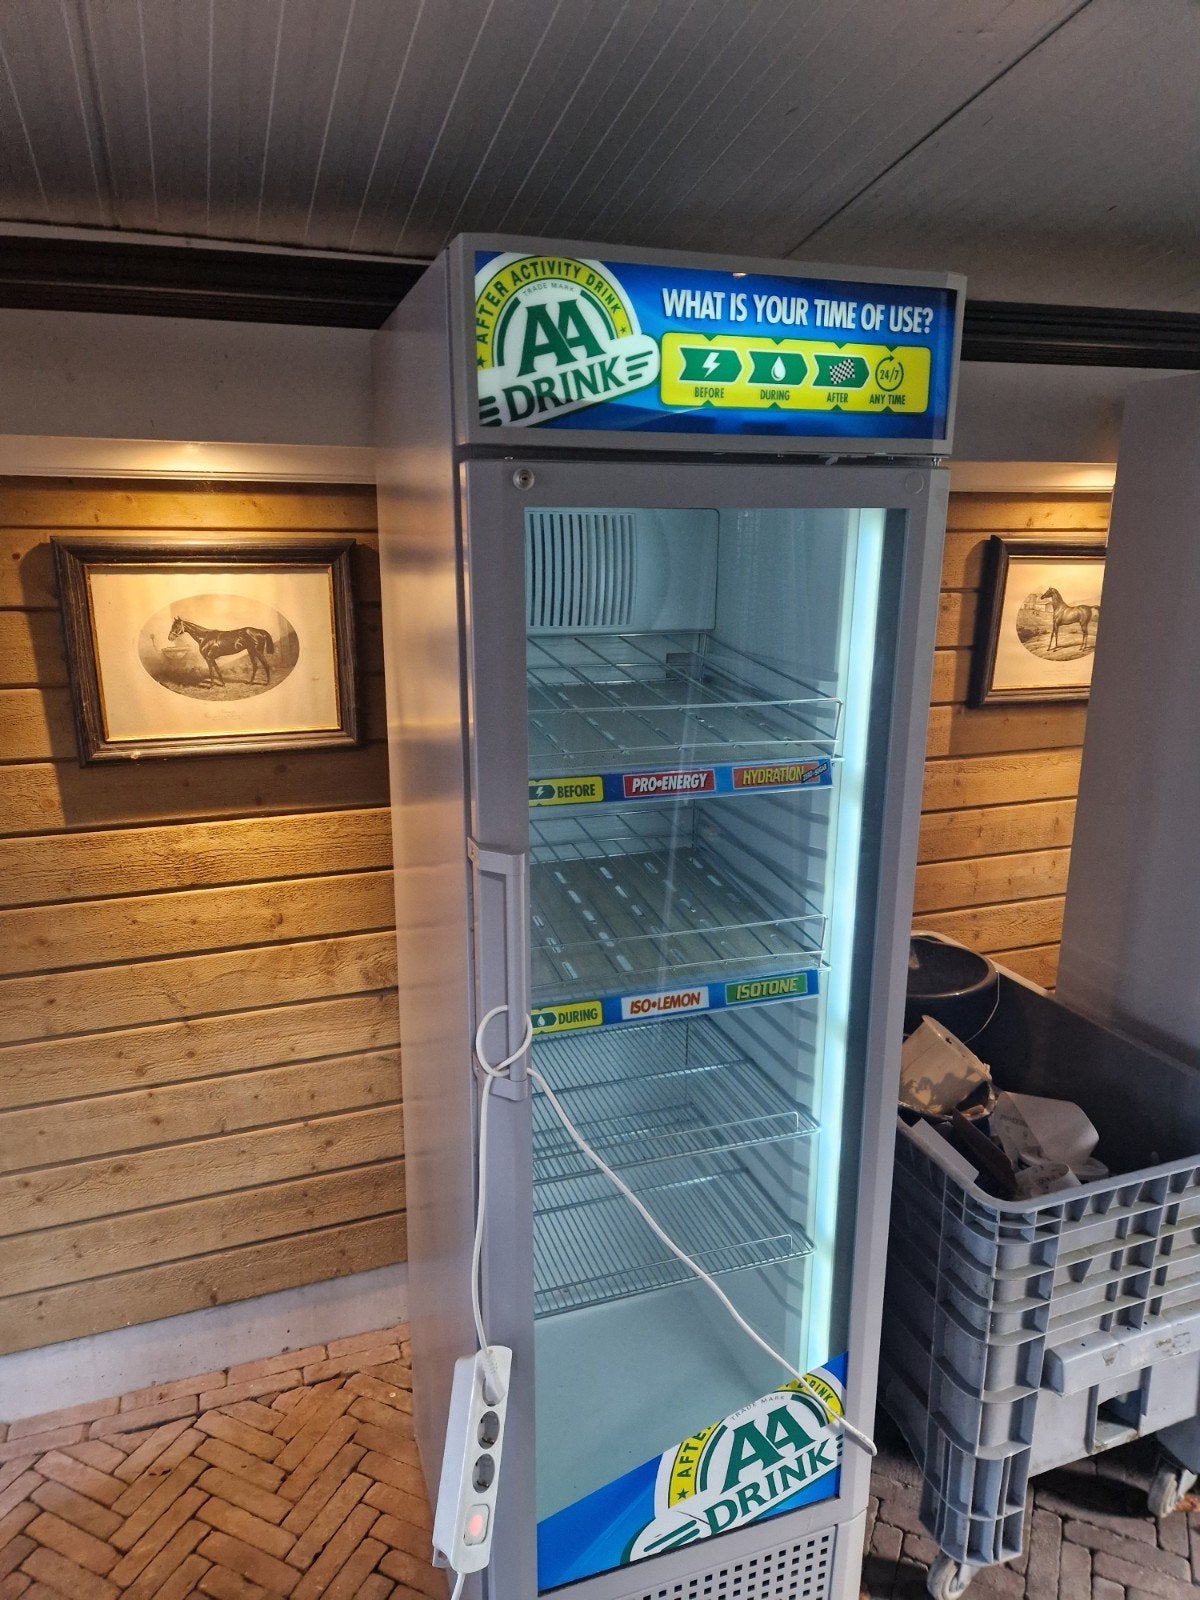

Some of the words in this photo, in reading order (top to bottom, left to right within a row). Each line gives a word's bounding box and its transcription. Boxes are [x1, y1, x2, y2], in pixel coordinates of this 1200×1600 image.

[522, 282, 548, 297] TRADE
[551, 282, 575, 293] MARK
[476, 281, 509, 345] AFTER
[510, 260, 582, 287] ACTIVITY
[585, 272, 622, 314] DRINK
[662, 287, 725, 320] WHAT
[730, 292, 747, 322] IS
[753, 294, 808, 326] YOUR
[814, 299, 857, 330] TIME
[861, 303, 885, 331] OF
[889, 304, 934, 334] USE?
[516, 299, 607, 378] AA
[879, 369, 899, 381] 24/7
[502, 355, 626, 423] DRINK
[694, 386, 725, 399] BEFORE
[760, 389, 790, 402] DURING
[826, 392, 849, 404] AFTER
[869, 393, 885, 405] ANY
[888, 394, 906, 406] TIME
[743, 765, 804, 785] HYDRATION
[557, 783, 596, 799] BEFORE
[736, 976, 798, 1000] ISOTONE
[558, 1008, 598, 1024] DURING
[676, 1426, 711, 1478] AFTE
[720, 1405, 817, 1494] AA
[703, 1438, 835, 1536] DRINK
